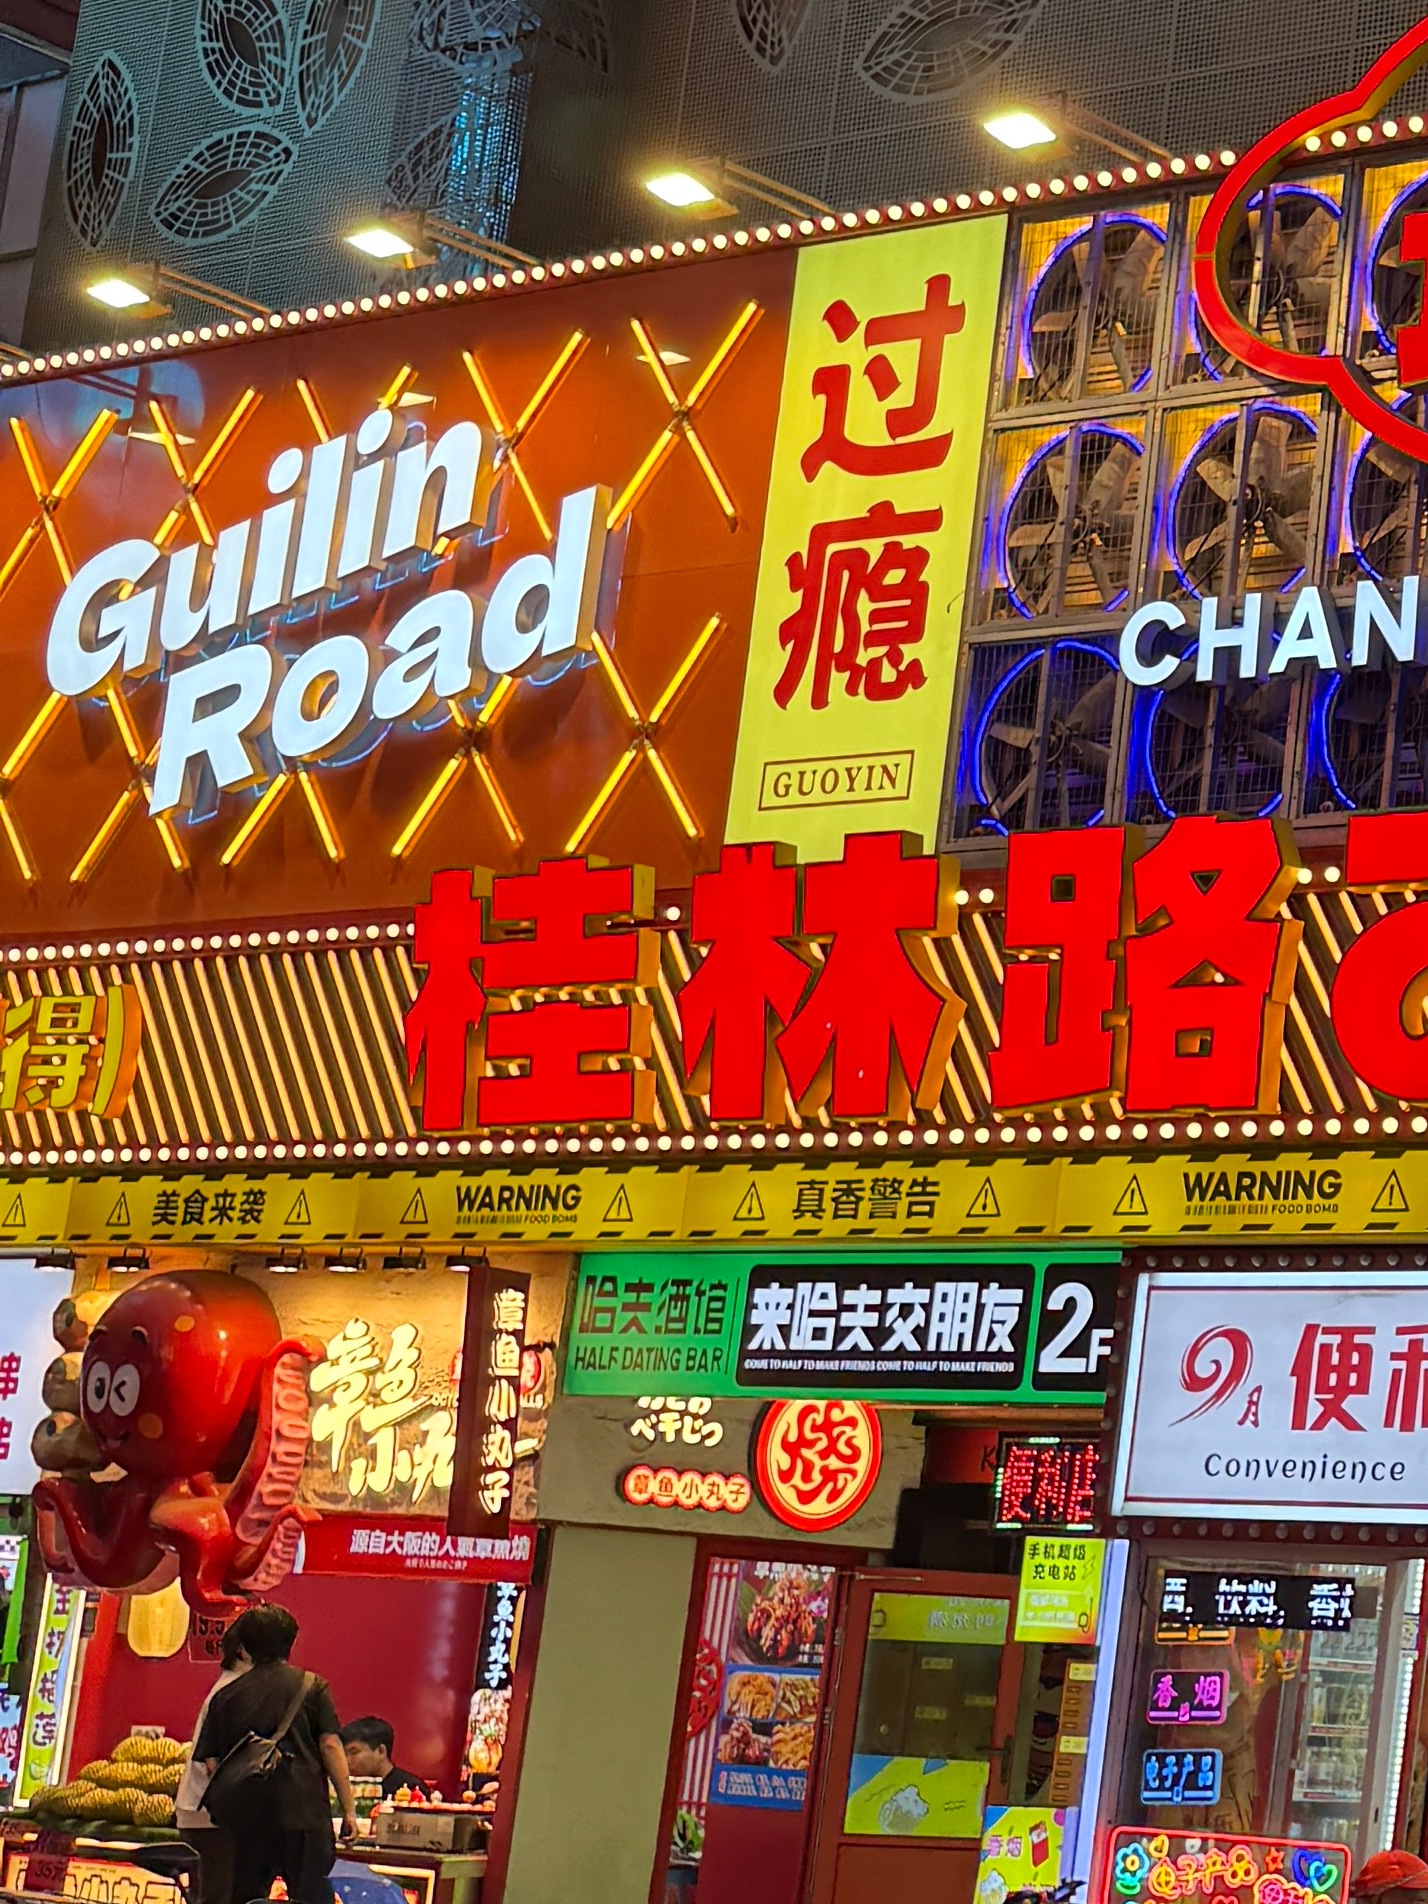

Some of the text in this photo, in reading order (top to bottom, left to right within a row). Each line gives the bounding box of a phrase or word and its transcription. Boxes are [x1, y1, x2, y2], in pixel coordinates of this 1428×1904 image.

[773, 274, 967, 712] 过瘾
[46, 408, 490, 699] Guilin
[150, 484, 615, 818] Road
[770, 761, 905, 799] GUOYIN
[456, 1183, 582, 1212] WARNING
[792, 1177, 940, 1221] 真香警告
[1183, 1169, 1343, 1203] WARNING
[151, 1188, 267, 1226] 美食来袭
[1272, 1203, 1338, 1214] FOOD BOMB
[579, 1275, 728, 1335] 哈夫酒馆
[747, 1282, 1024, 1352] 来哈夫交朋友
[574, 1346, 724, 1373] HALF DATING BAR
[1205, 1452, 1405, 1483] Convenience
[629, 1470, 748, 1506] 章鱼小丸子
